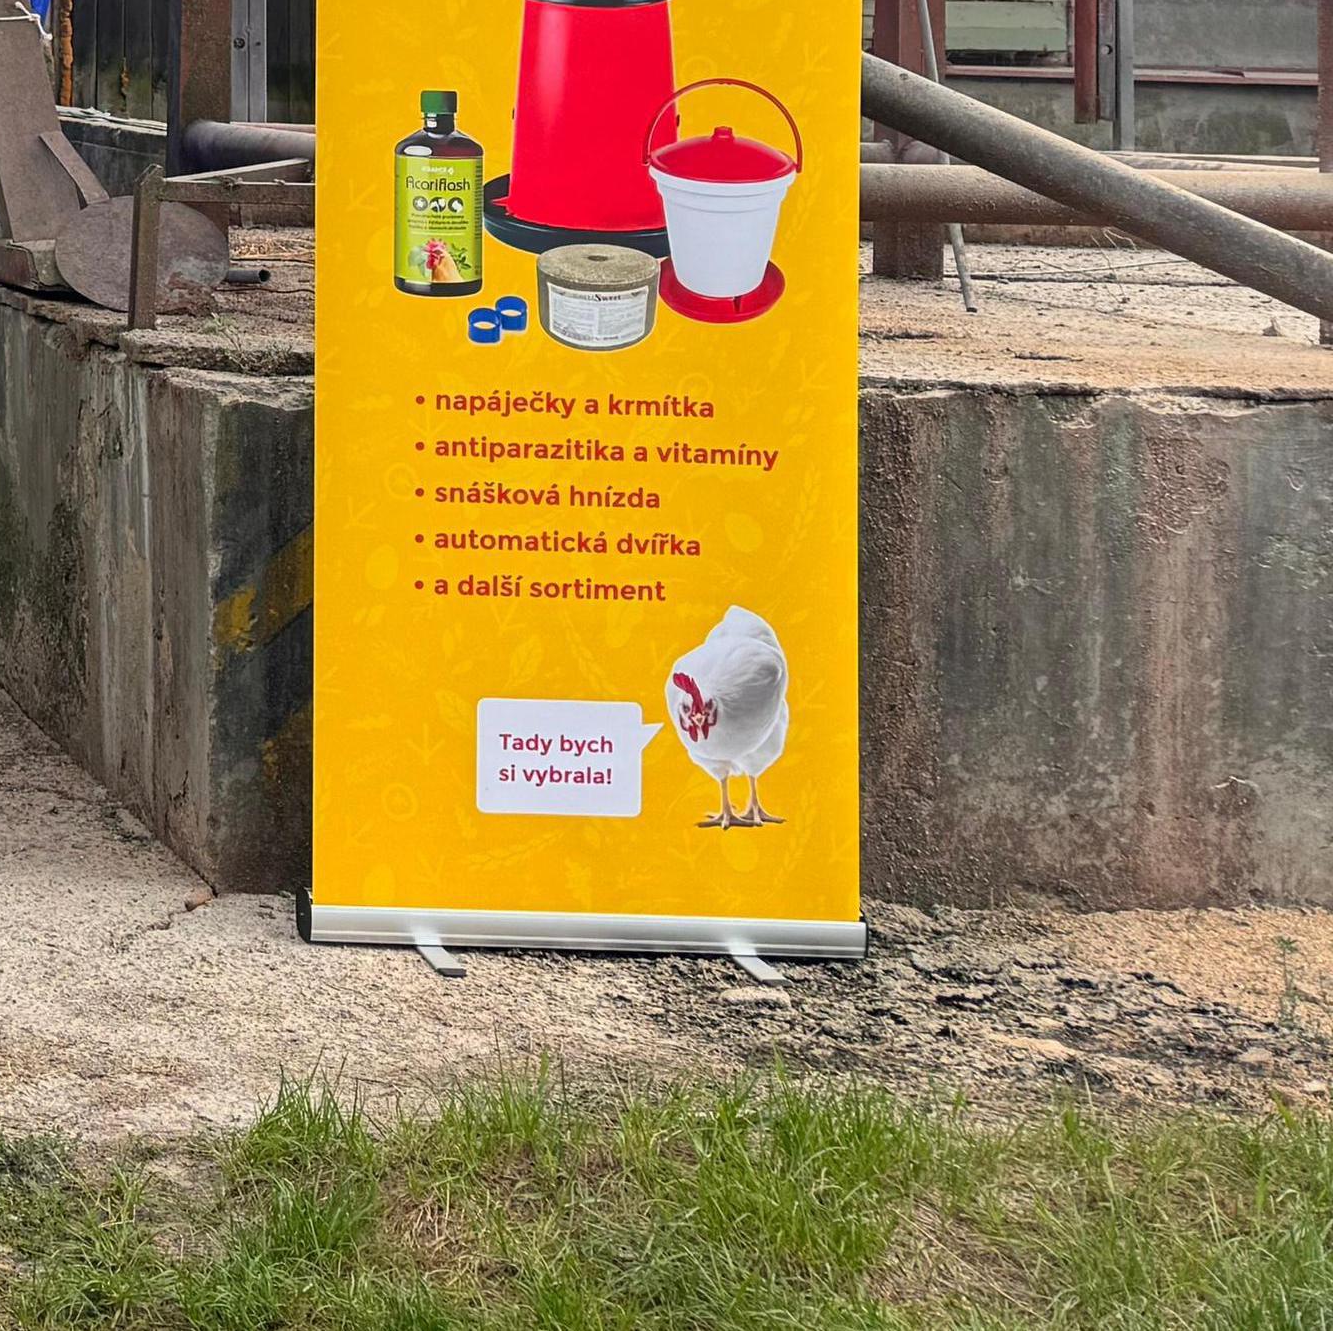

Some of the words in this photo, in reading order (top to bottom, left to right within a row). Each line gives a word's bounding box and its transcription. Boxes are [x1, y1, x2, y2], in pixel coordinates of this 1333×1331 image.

[436, 390, 575, 419] napáječky
[585, 399, 598, 414] a
[609, 394, 714, 418] krmítka
[435, 436, 624, 462] antiparazitika
[634, 447, 647, 462] a
[657, 442, 778, 471] vitamíny
[435, 482, 559, 505] snášková
[570, 485, 660, 508] hnízda
[435, 530, 607, 553] automatická
[617, 533, 700, 556] dvířka
[435, 579, 448, 595] a
[458, 575, 523, 597] další
[530, 578, 665, 601] sortiment
[499, 734, 552, 755] Tady
[560, 735, 612, 756] bych
[499, 765, 515, 781] si
[523, 765, 611, 786] vybrala!
